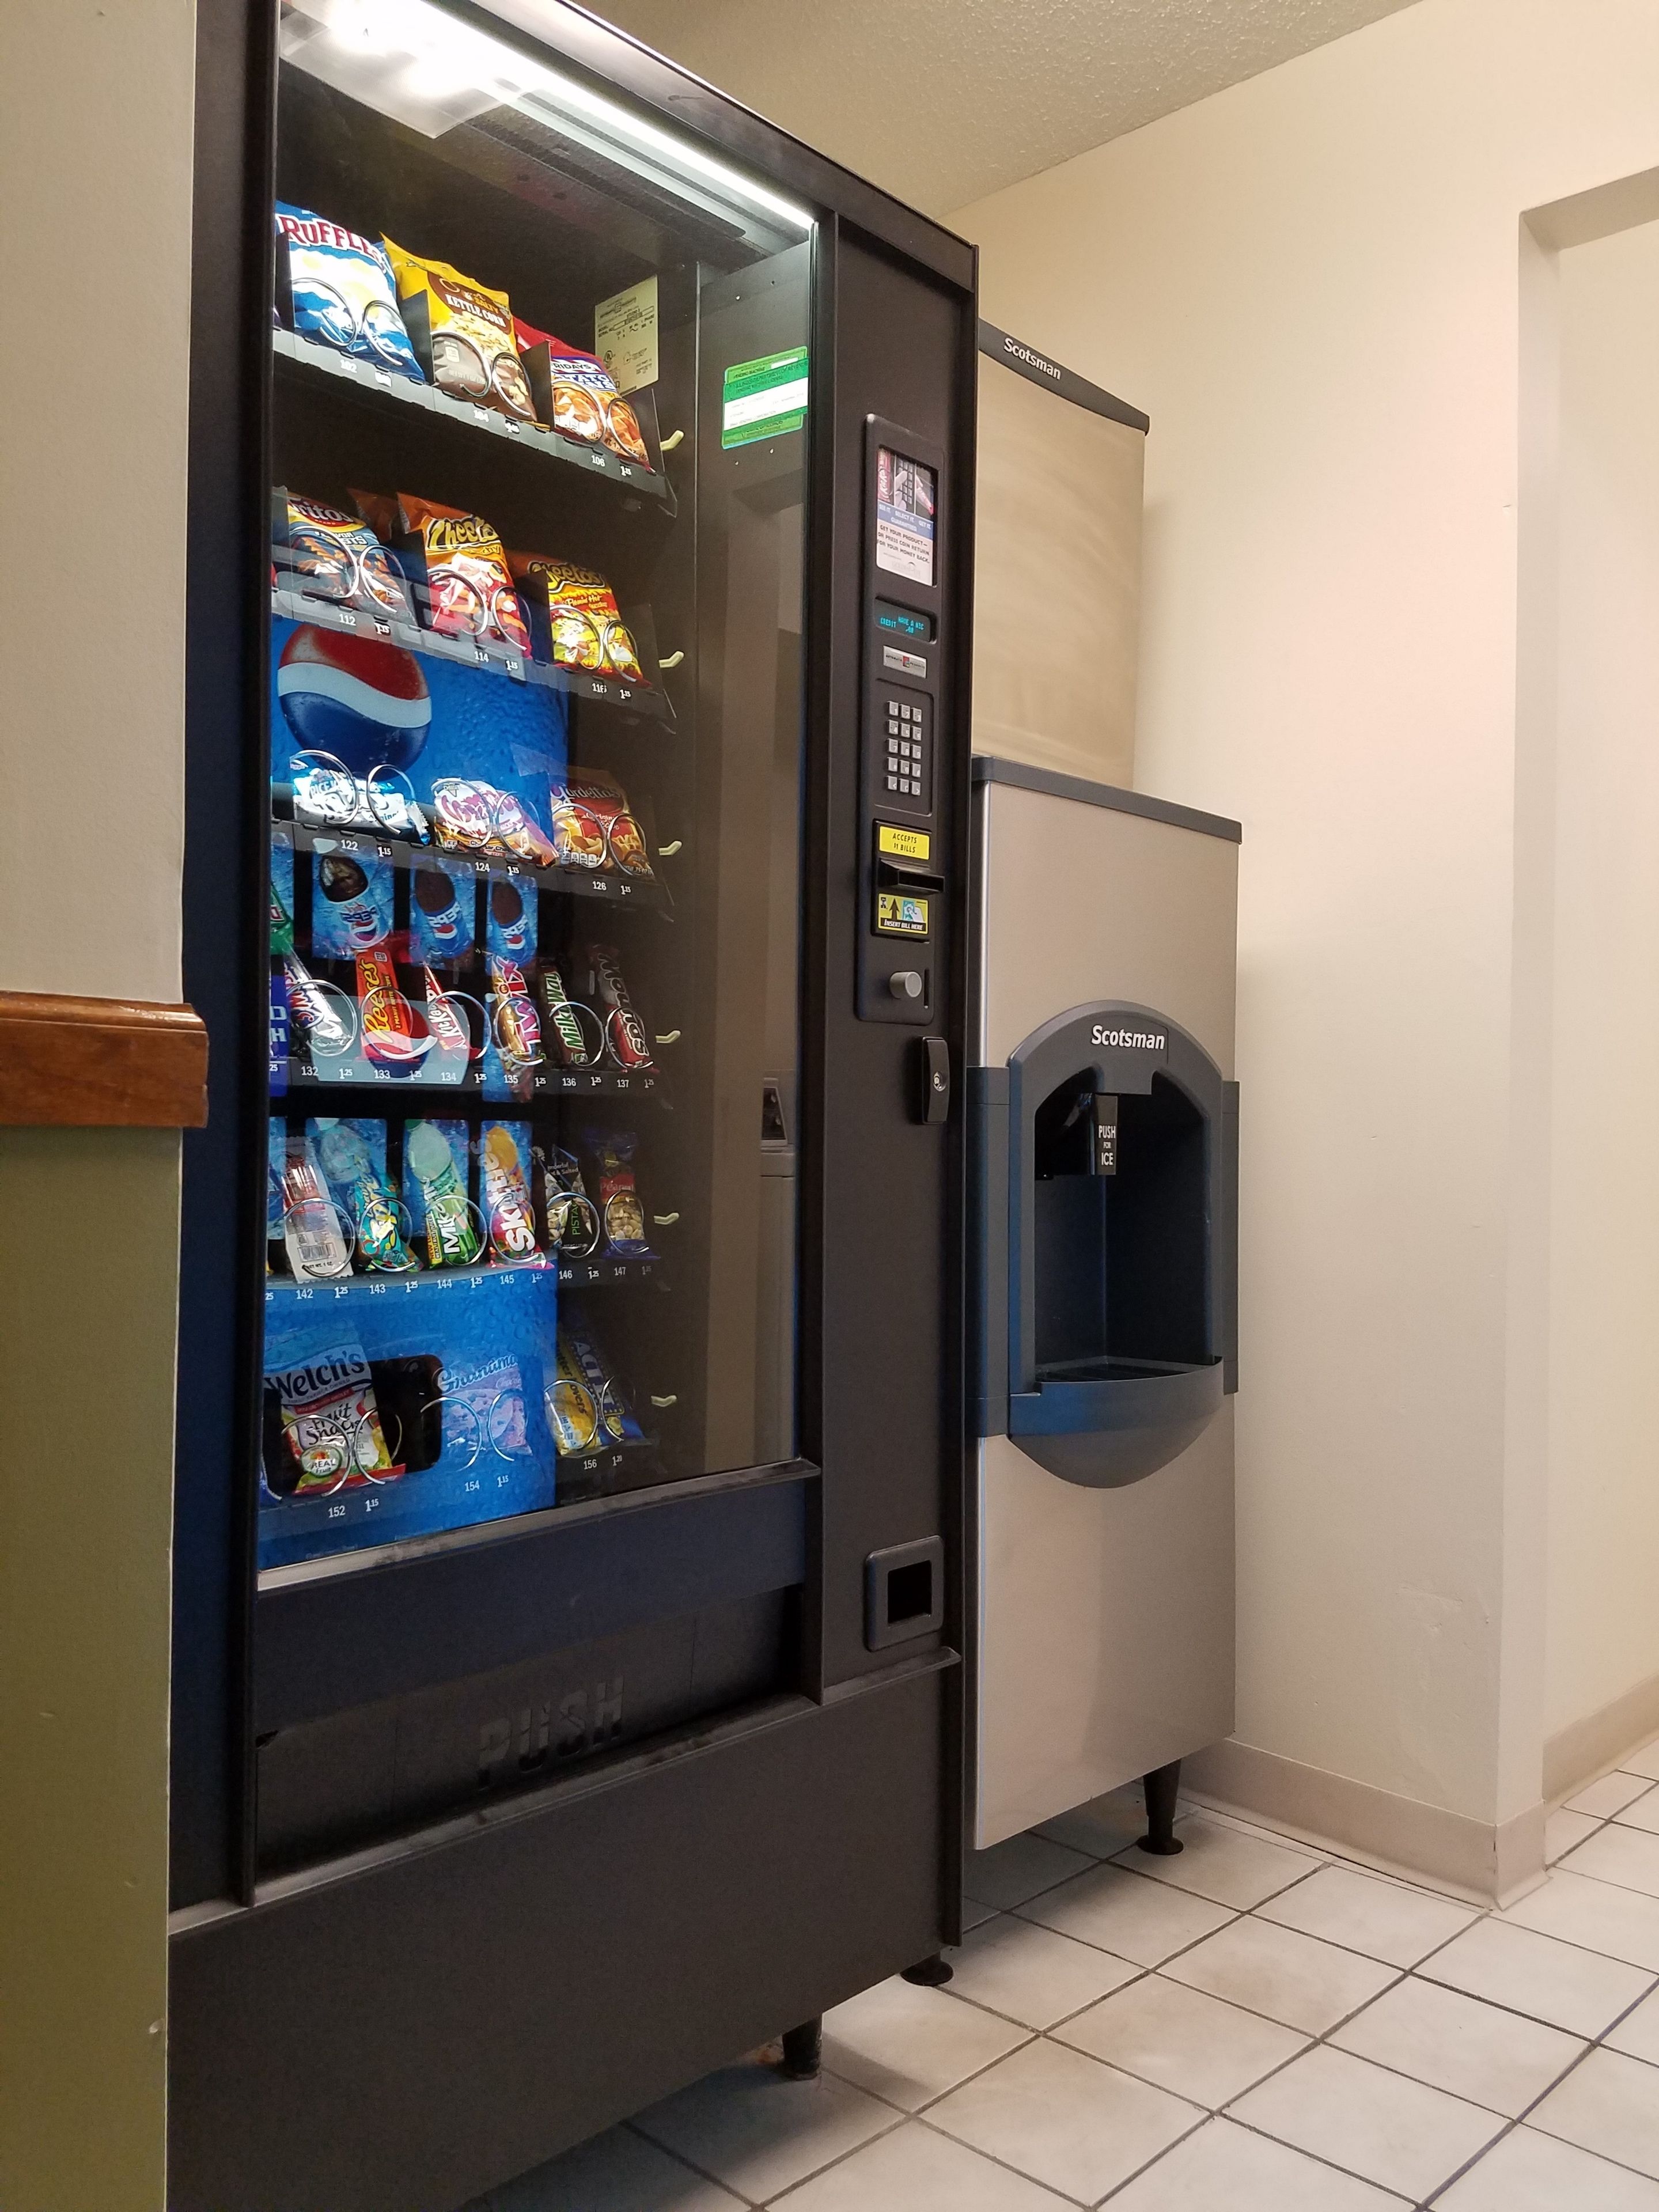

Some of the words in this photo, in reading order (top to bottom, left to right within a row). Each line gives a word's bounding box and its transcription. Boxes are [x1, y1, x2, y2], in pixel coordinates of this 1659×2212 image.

[445, 294, 483, 317] KETTLE
[483, 310, 506, 327] CORN
[1003, 337, 1062, 380] Scotsman
[890, 529, 902, 537] YOUR
[885, 535, 898, 544] PRESS
[911, 545, 930, 556] RETURN
[900, 548, 915, 558] MONEY
[588, 594, 603, 603] Hot
[339, 613, 357, 626] 112
[880, 618, 897, 628] CREDIT
[474, 651, 489, 662] 114
[892, 833, 917, 843] ACCEPTS
[341, 839, 358, 851] 122
[900, 844, 915, 853] BILLS
[475, 862, 490, 872] 124
[592, 881, 607, 891] 126
[884, 919, 901, 928] INSERT
[901, 921, 911, 929] BILL
[544, 971, 567, 1004] Way
[496, 955, 541, 1054] TWIX
[1091, 1024, 1165, 1050] Scotsman
[301, 1066, 319, 1076] 132
[374, 1070, 391, 1080] 133
[441, 1072, 456, 1081] 134
[503, 1075, 518, 1084] 135
[562, 1078, 577, 1086] 136
[616, 1079, 629, 1088] 137
[1098, 1125, 1116, 1139] PUSH
[1101, 1152, 1113, 1166] ICE
[435, 1203, 461, 1254] Mike
[559, 1270, 573, 1279] 146
[614, 1267, 626, 1276] 147
[437, 1279, 452, 1289] 144
[500, 1274, 514, 1285] 145
[369, 1284, 386, 1294] 143
[296, 1289, 313, 1300] 142
[574, 1341, 603, 1378] ACT
[264, 1350, 365, 1399] Welch's
[569, 1384, 586, 1414] overs
[312, 1403, 353, 1430] Fruit
[312, 1460, 336, 1469] REAL
[584, 1459, 597, 1469] 156
[465, 1480, 480, 1492] 154
[328, 1506, 346, 1518] 152
[479, 1674, 624, 1770] PUSH
